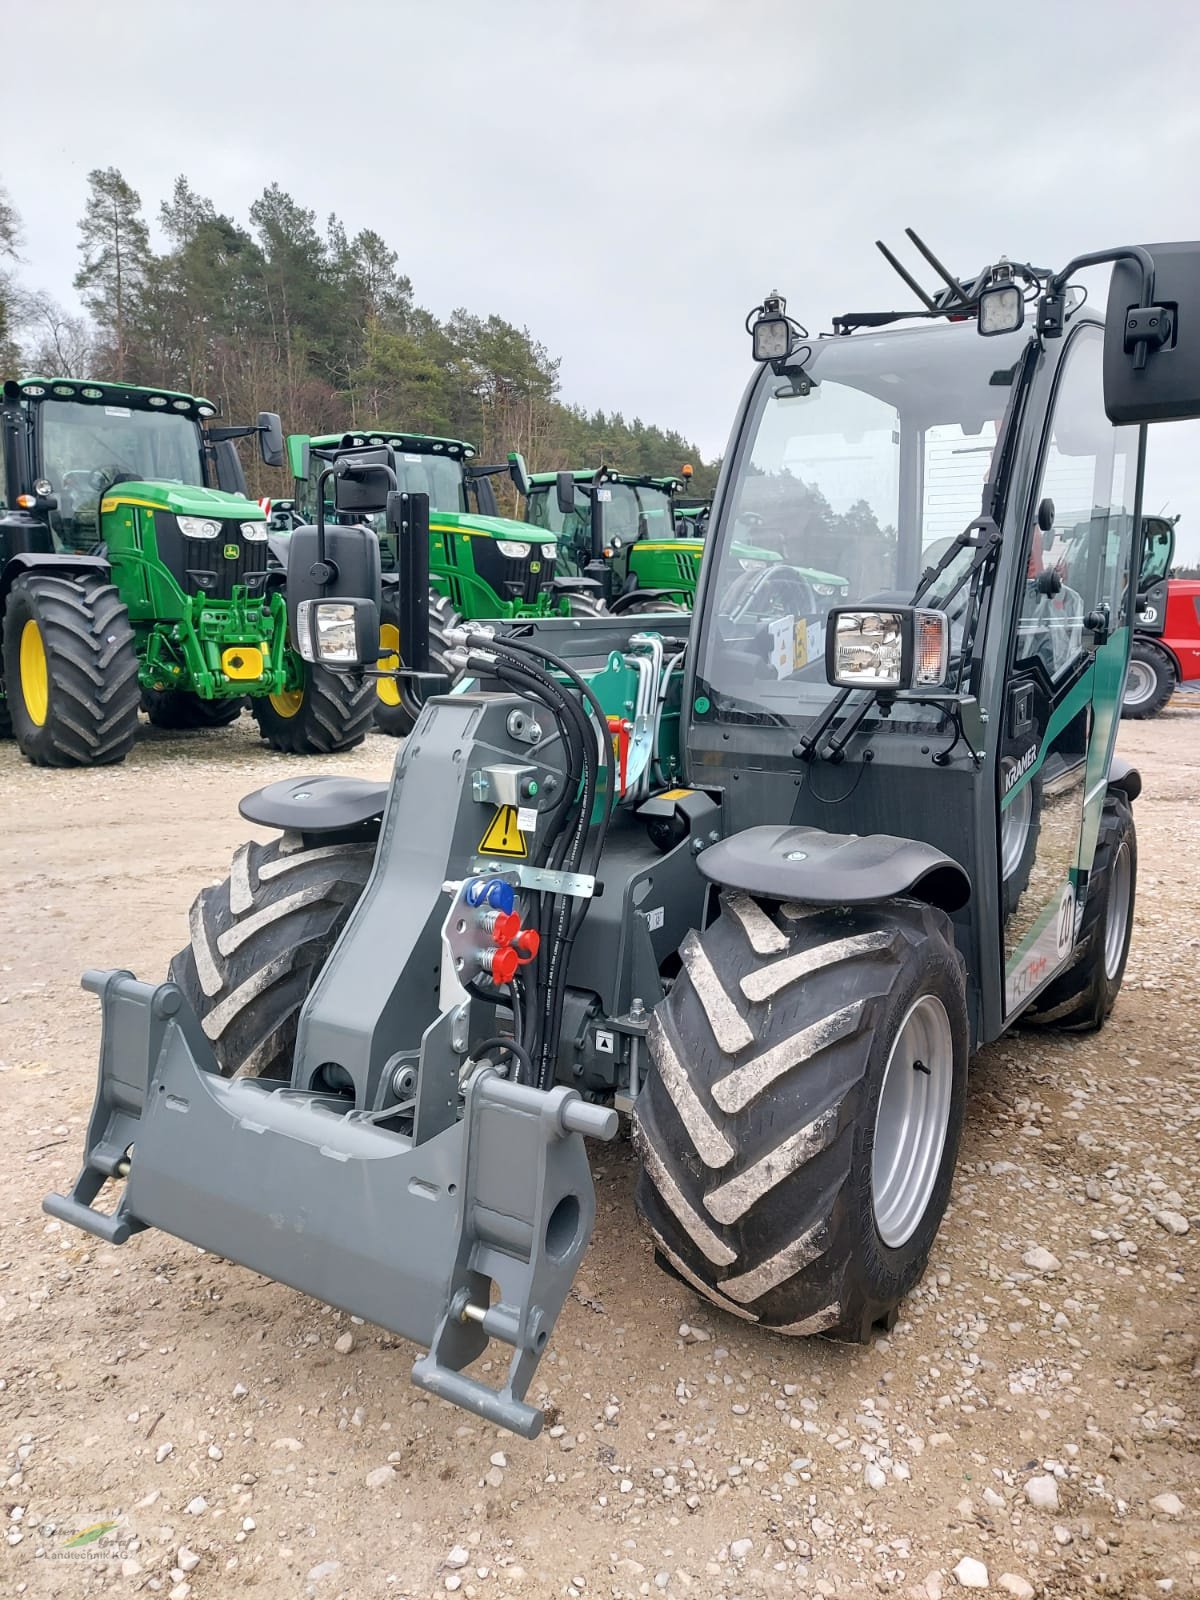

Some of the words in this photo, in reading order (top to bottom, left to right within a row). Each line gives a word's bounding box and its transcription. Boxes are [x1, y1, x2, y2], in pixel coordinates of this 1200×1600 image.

[1143, 610, 1153, 620] 20
[1005, 743, 1037, 793] KRAMER
[1058, 894, 1073, 949] 20
